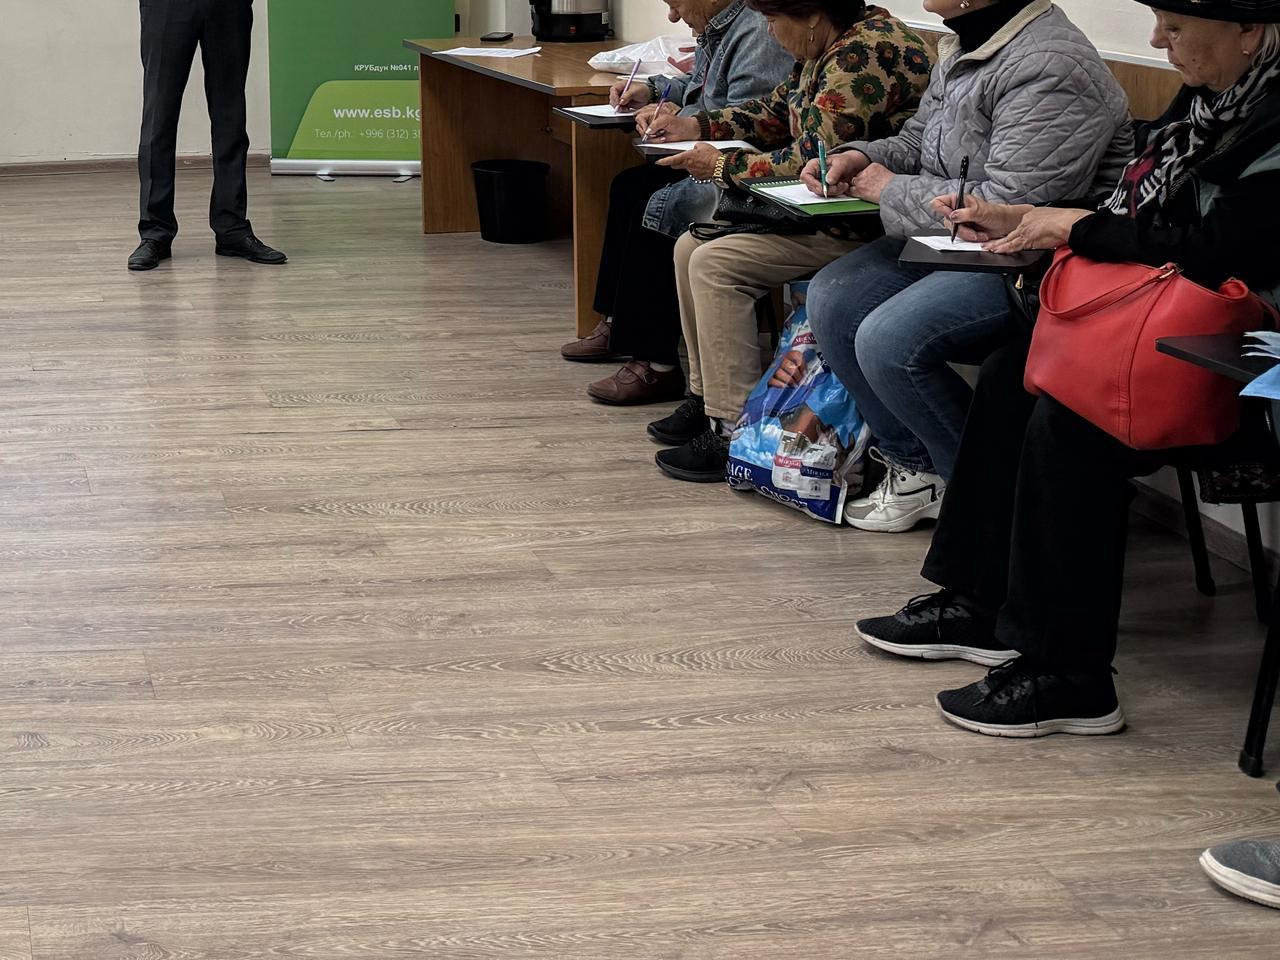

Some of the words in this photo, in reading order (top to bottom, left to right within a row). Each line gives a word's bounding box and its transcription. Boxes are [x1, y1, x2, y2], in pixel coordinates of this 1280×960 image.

[390, 64, 411, 72] №041
[359, 129, 384, 139] +996
[386, 128, 409, 140] (312)
